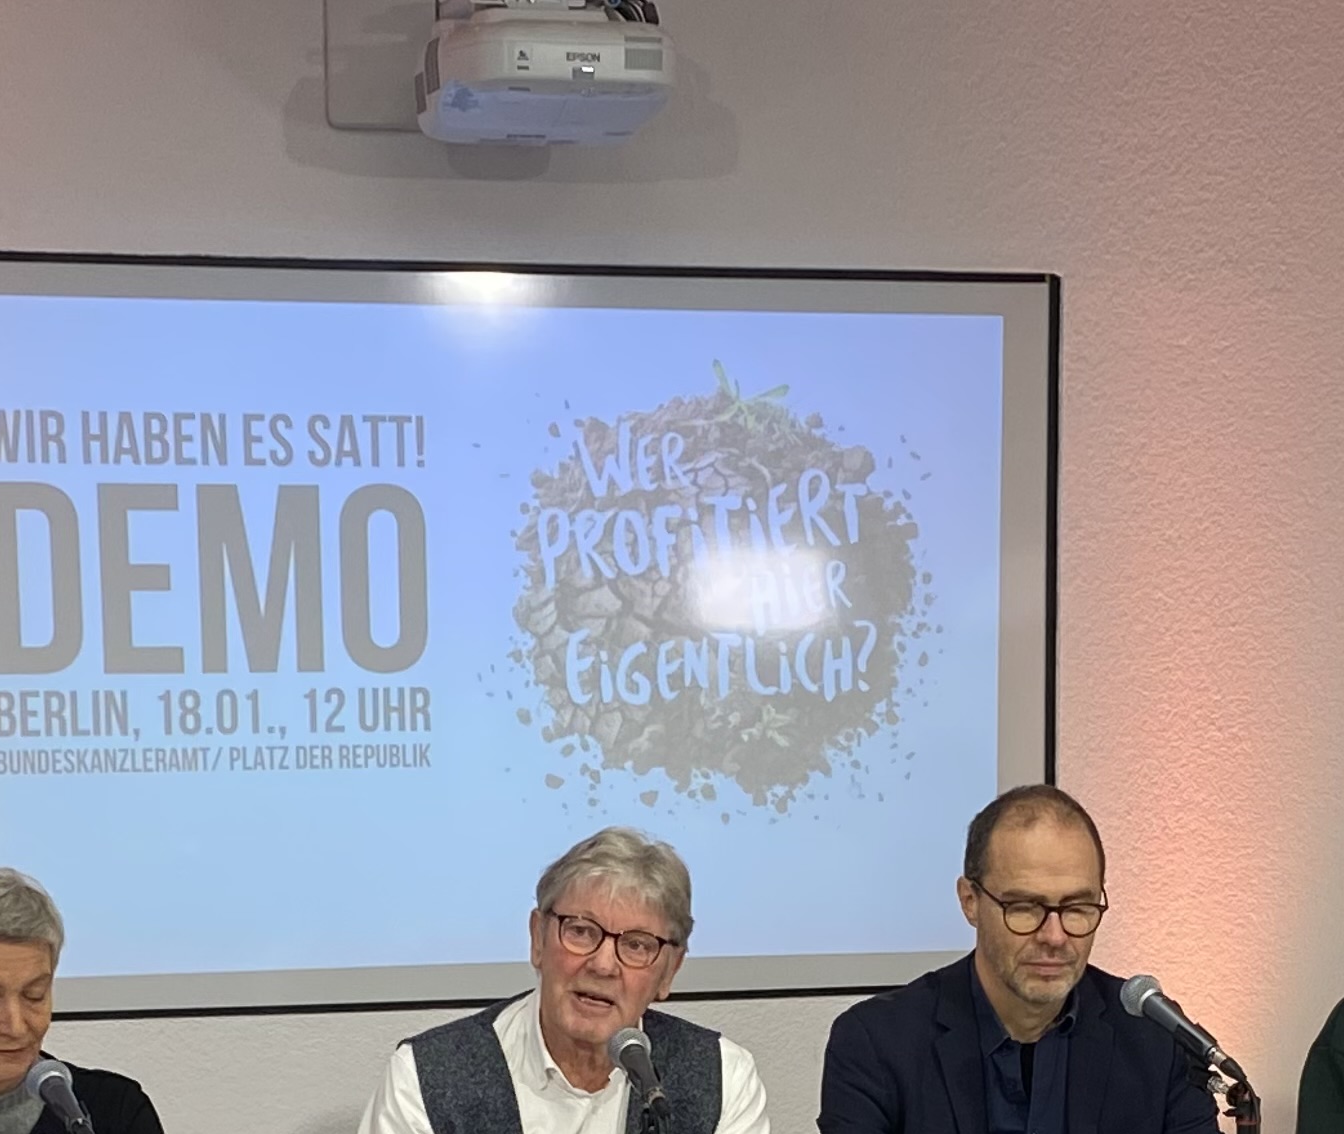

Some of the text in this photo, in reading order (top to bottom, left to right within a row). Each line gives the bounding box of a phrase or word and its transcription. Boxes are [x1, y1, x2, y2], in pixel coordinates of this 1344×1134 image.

[566, 51, 601, 63] EPSON
[81, 411, 228, 467] HABEN
[243, 413, 294, 467] ES
[307, 414, 426, 468] SATT!
[573, 417, 696, 499] WER
[157, 688, 288, 740] 18.01.,
[303, 688, 347, 734] 12
[359, 686, 432, 733] UHR
[229, 746, 291, 772] PLATZ
[295, 745, 334, 770] DER
[339, 743, 432, 770] REPUBLIK
